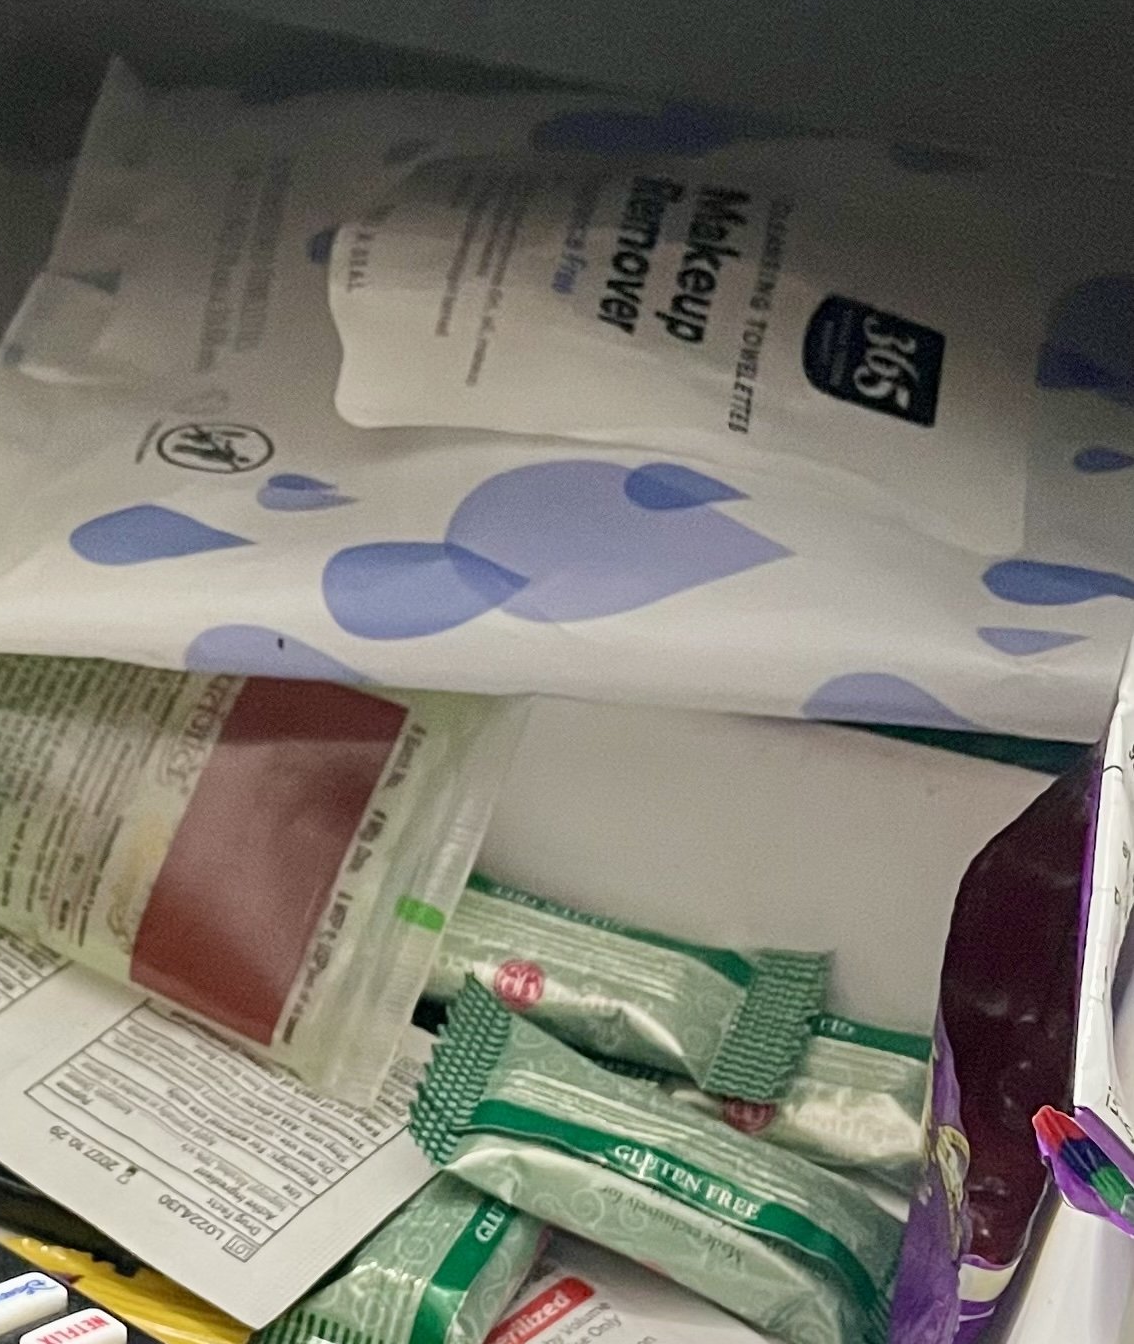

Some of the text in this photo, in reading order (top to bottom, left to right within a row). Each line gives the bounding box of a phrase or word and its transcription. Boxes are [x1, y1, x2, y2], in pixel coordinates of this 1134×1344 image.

[598, 175, 687, 335] Remover
[655, 184, 753, 344] Makeup
[852, 313, 922, 412] 365
[278, 1180, 303, 1202] Use
[614, 1143, 762, 1221] GLUTEN FREE
[203, 1195, 264, 1238] Drug Facts
[474, 1202, 508, 1244] GLU
[586, 1310, 623, 1343] Only
